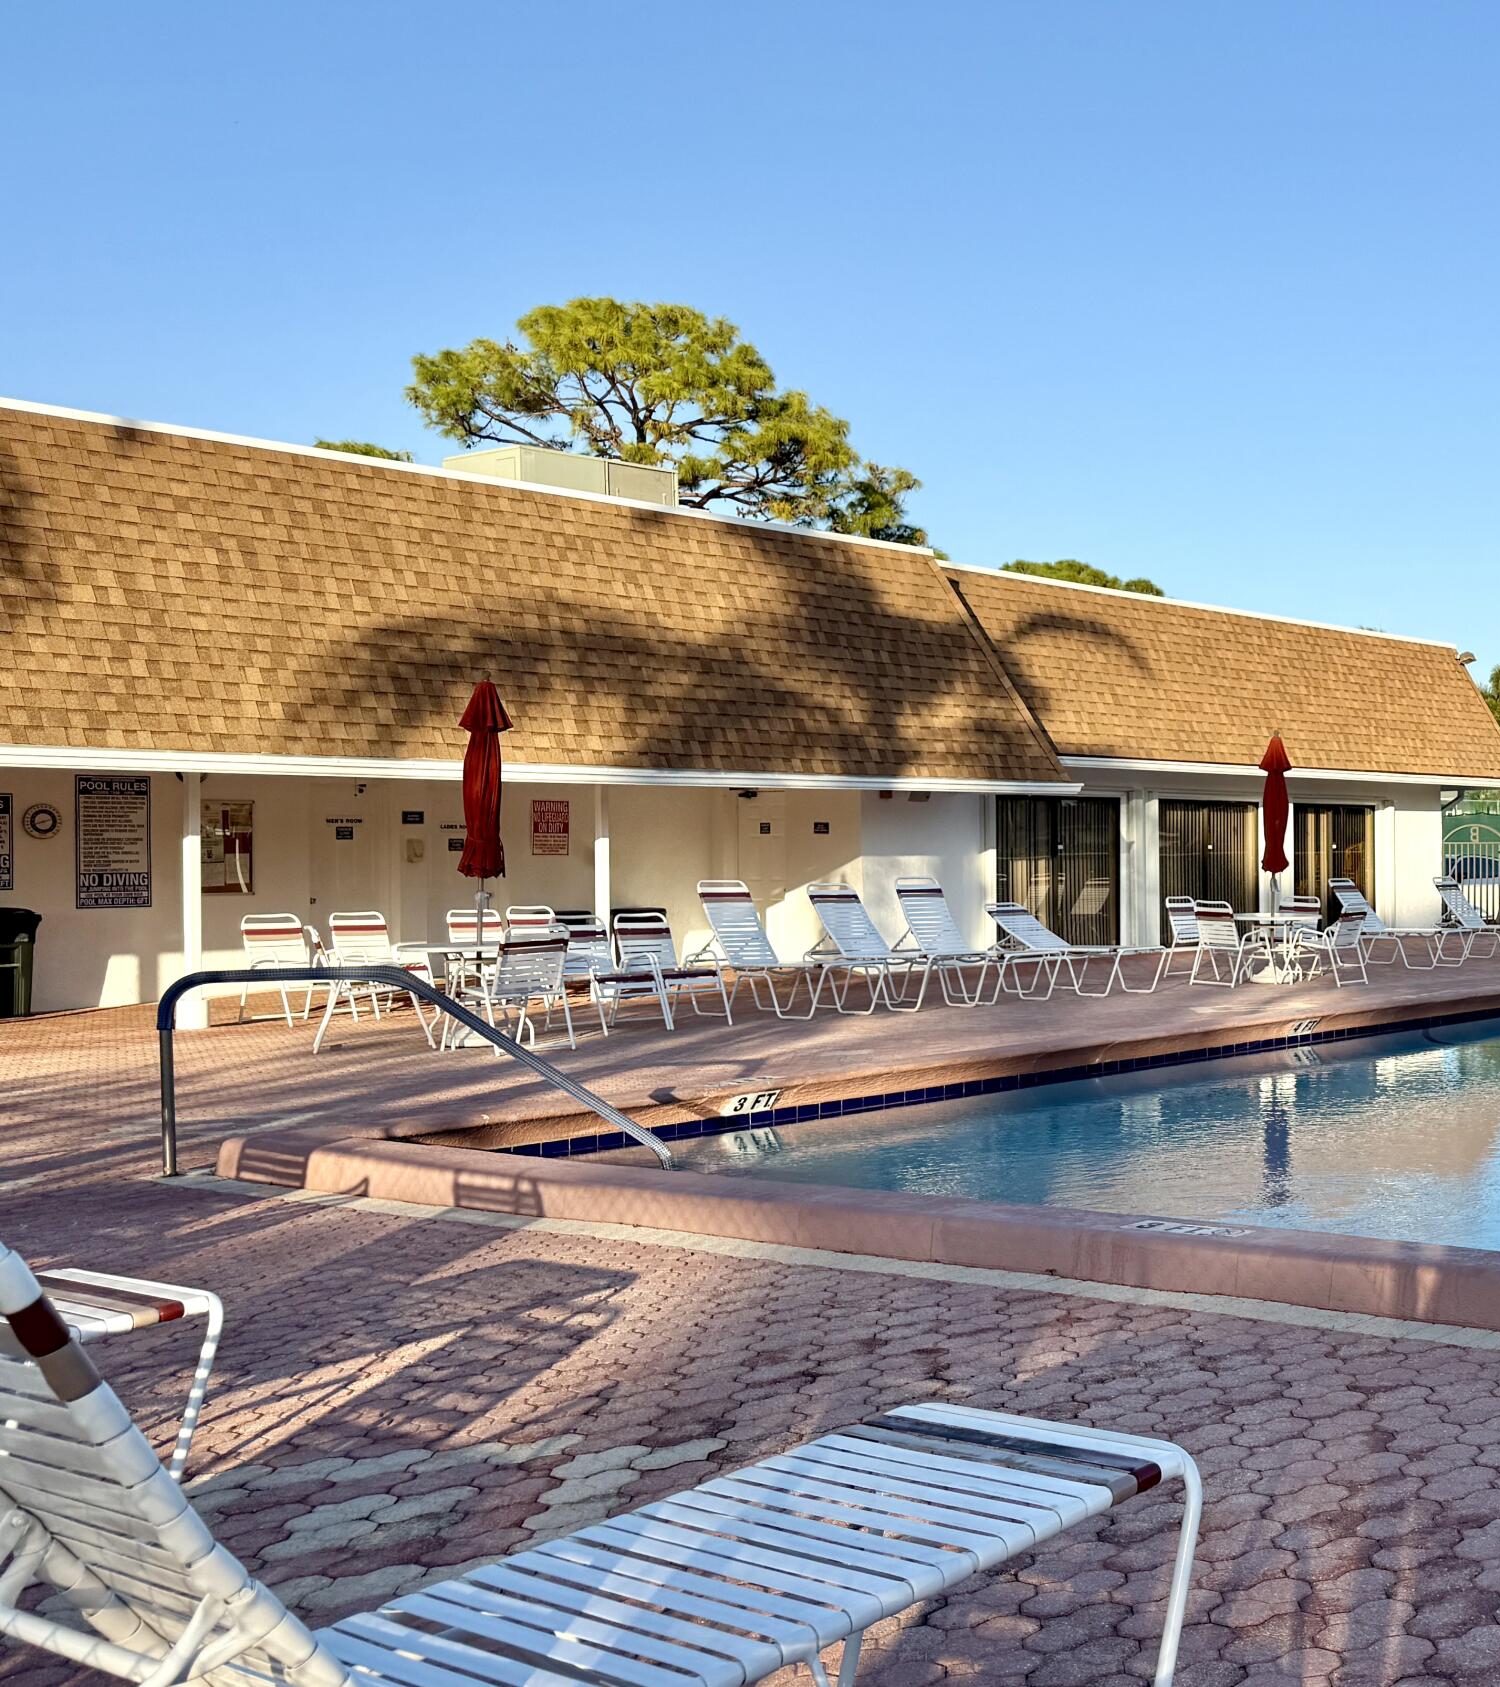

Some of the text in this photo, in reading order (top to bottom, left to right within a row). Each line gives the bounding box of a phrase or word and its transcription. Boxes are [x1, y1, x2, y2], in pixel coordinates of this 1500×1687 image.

[80, 781, 147, 791] POOL RULES
[533, 801, 568, 812] WARNING
[533, 812, 569, 822] NO LIFEGUARD
[538, 822, 564, 833] ON DUTY
[80, 873, 148, 886] NO DIVING
[733, 1096, 748, 1112] 3
